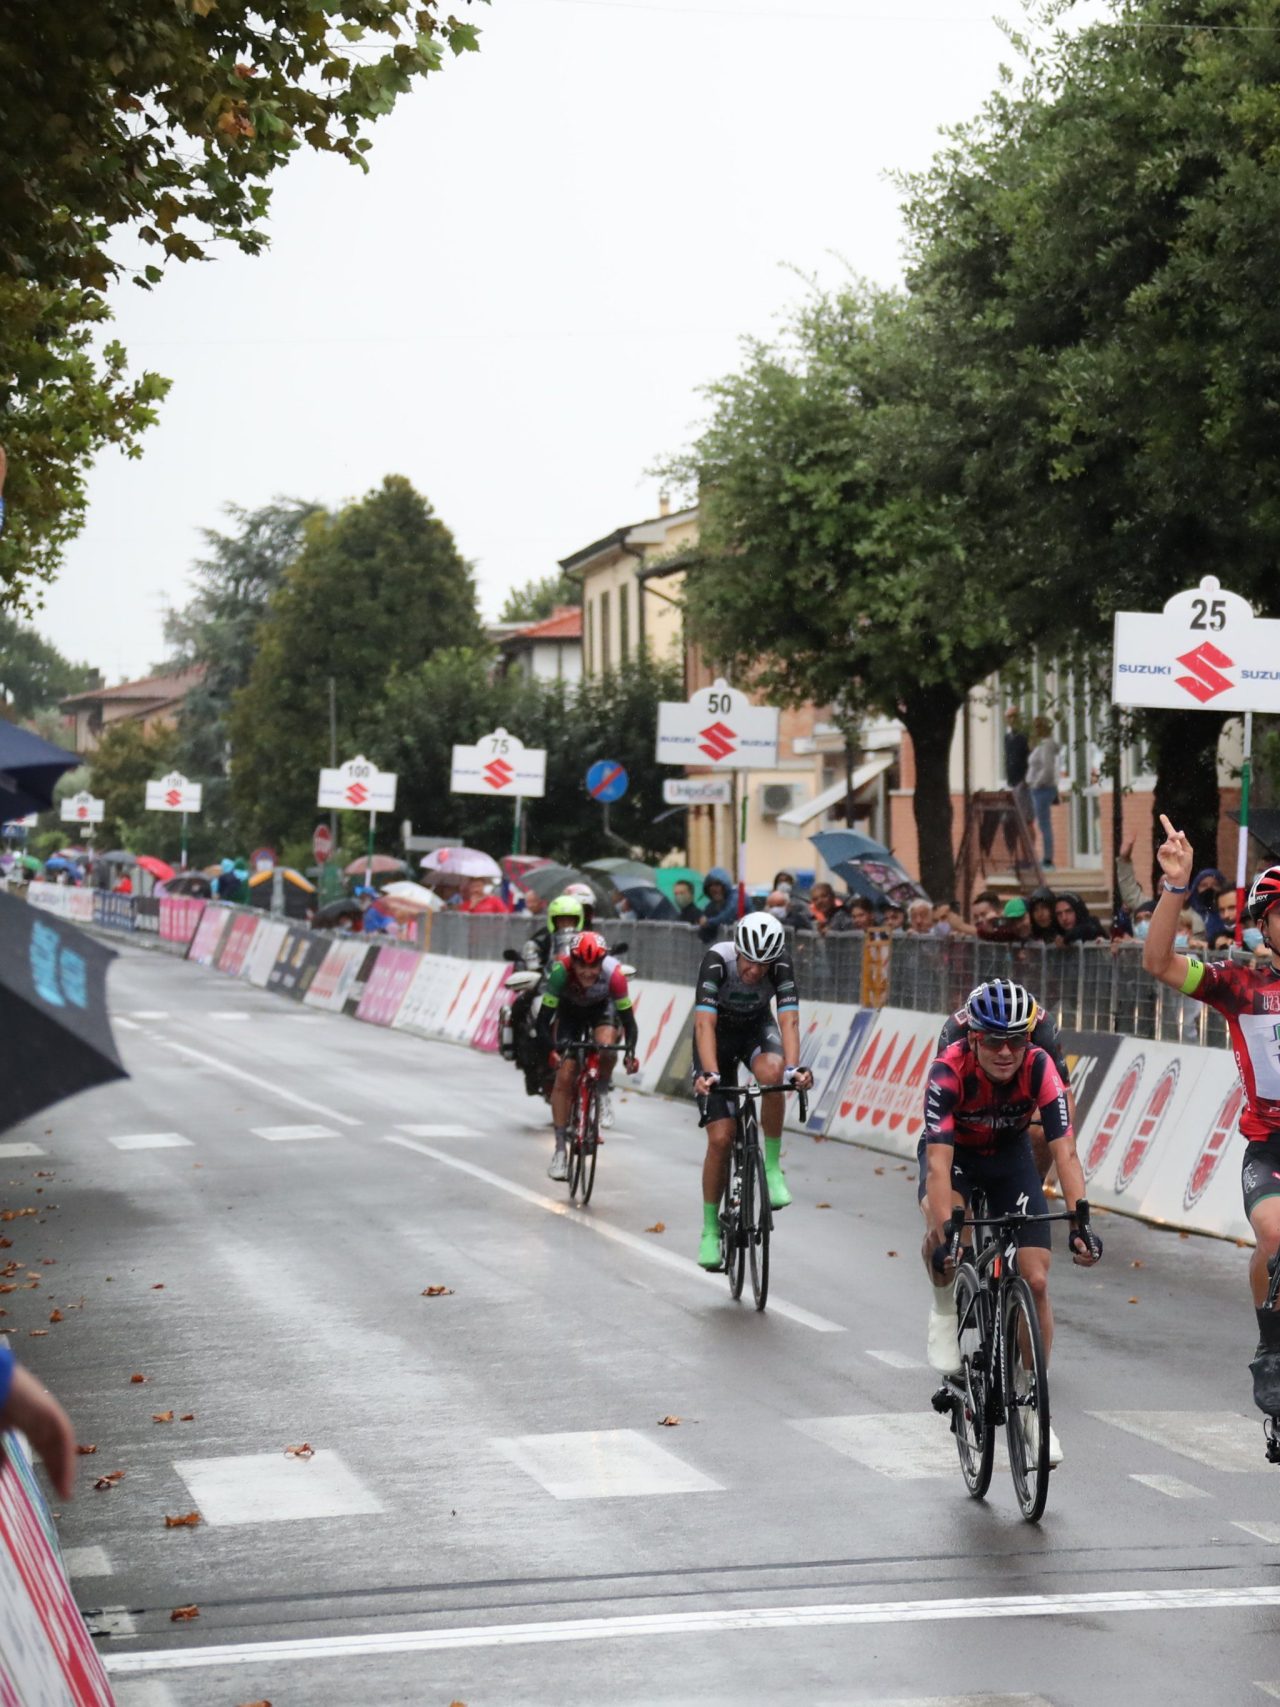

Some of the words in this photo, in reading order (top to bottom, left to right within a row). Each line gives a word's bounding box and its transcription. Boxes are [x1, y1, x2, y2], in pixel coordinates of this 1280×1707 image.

[1190, 599, 1226, 631] 25
[1118, 664, 1171, 675] SUZUKI
[708, 694, 731, 715] 50
[491, 739, 509, 754] 75
[348, 766, 370, 779] 100
[928, 1079, 943, 1134] MAAP
